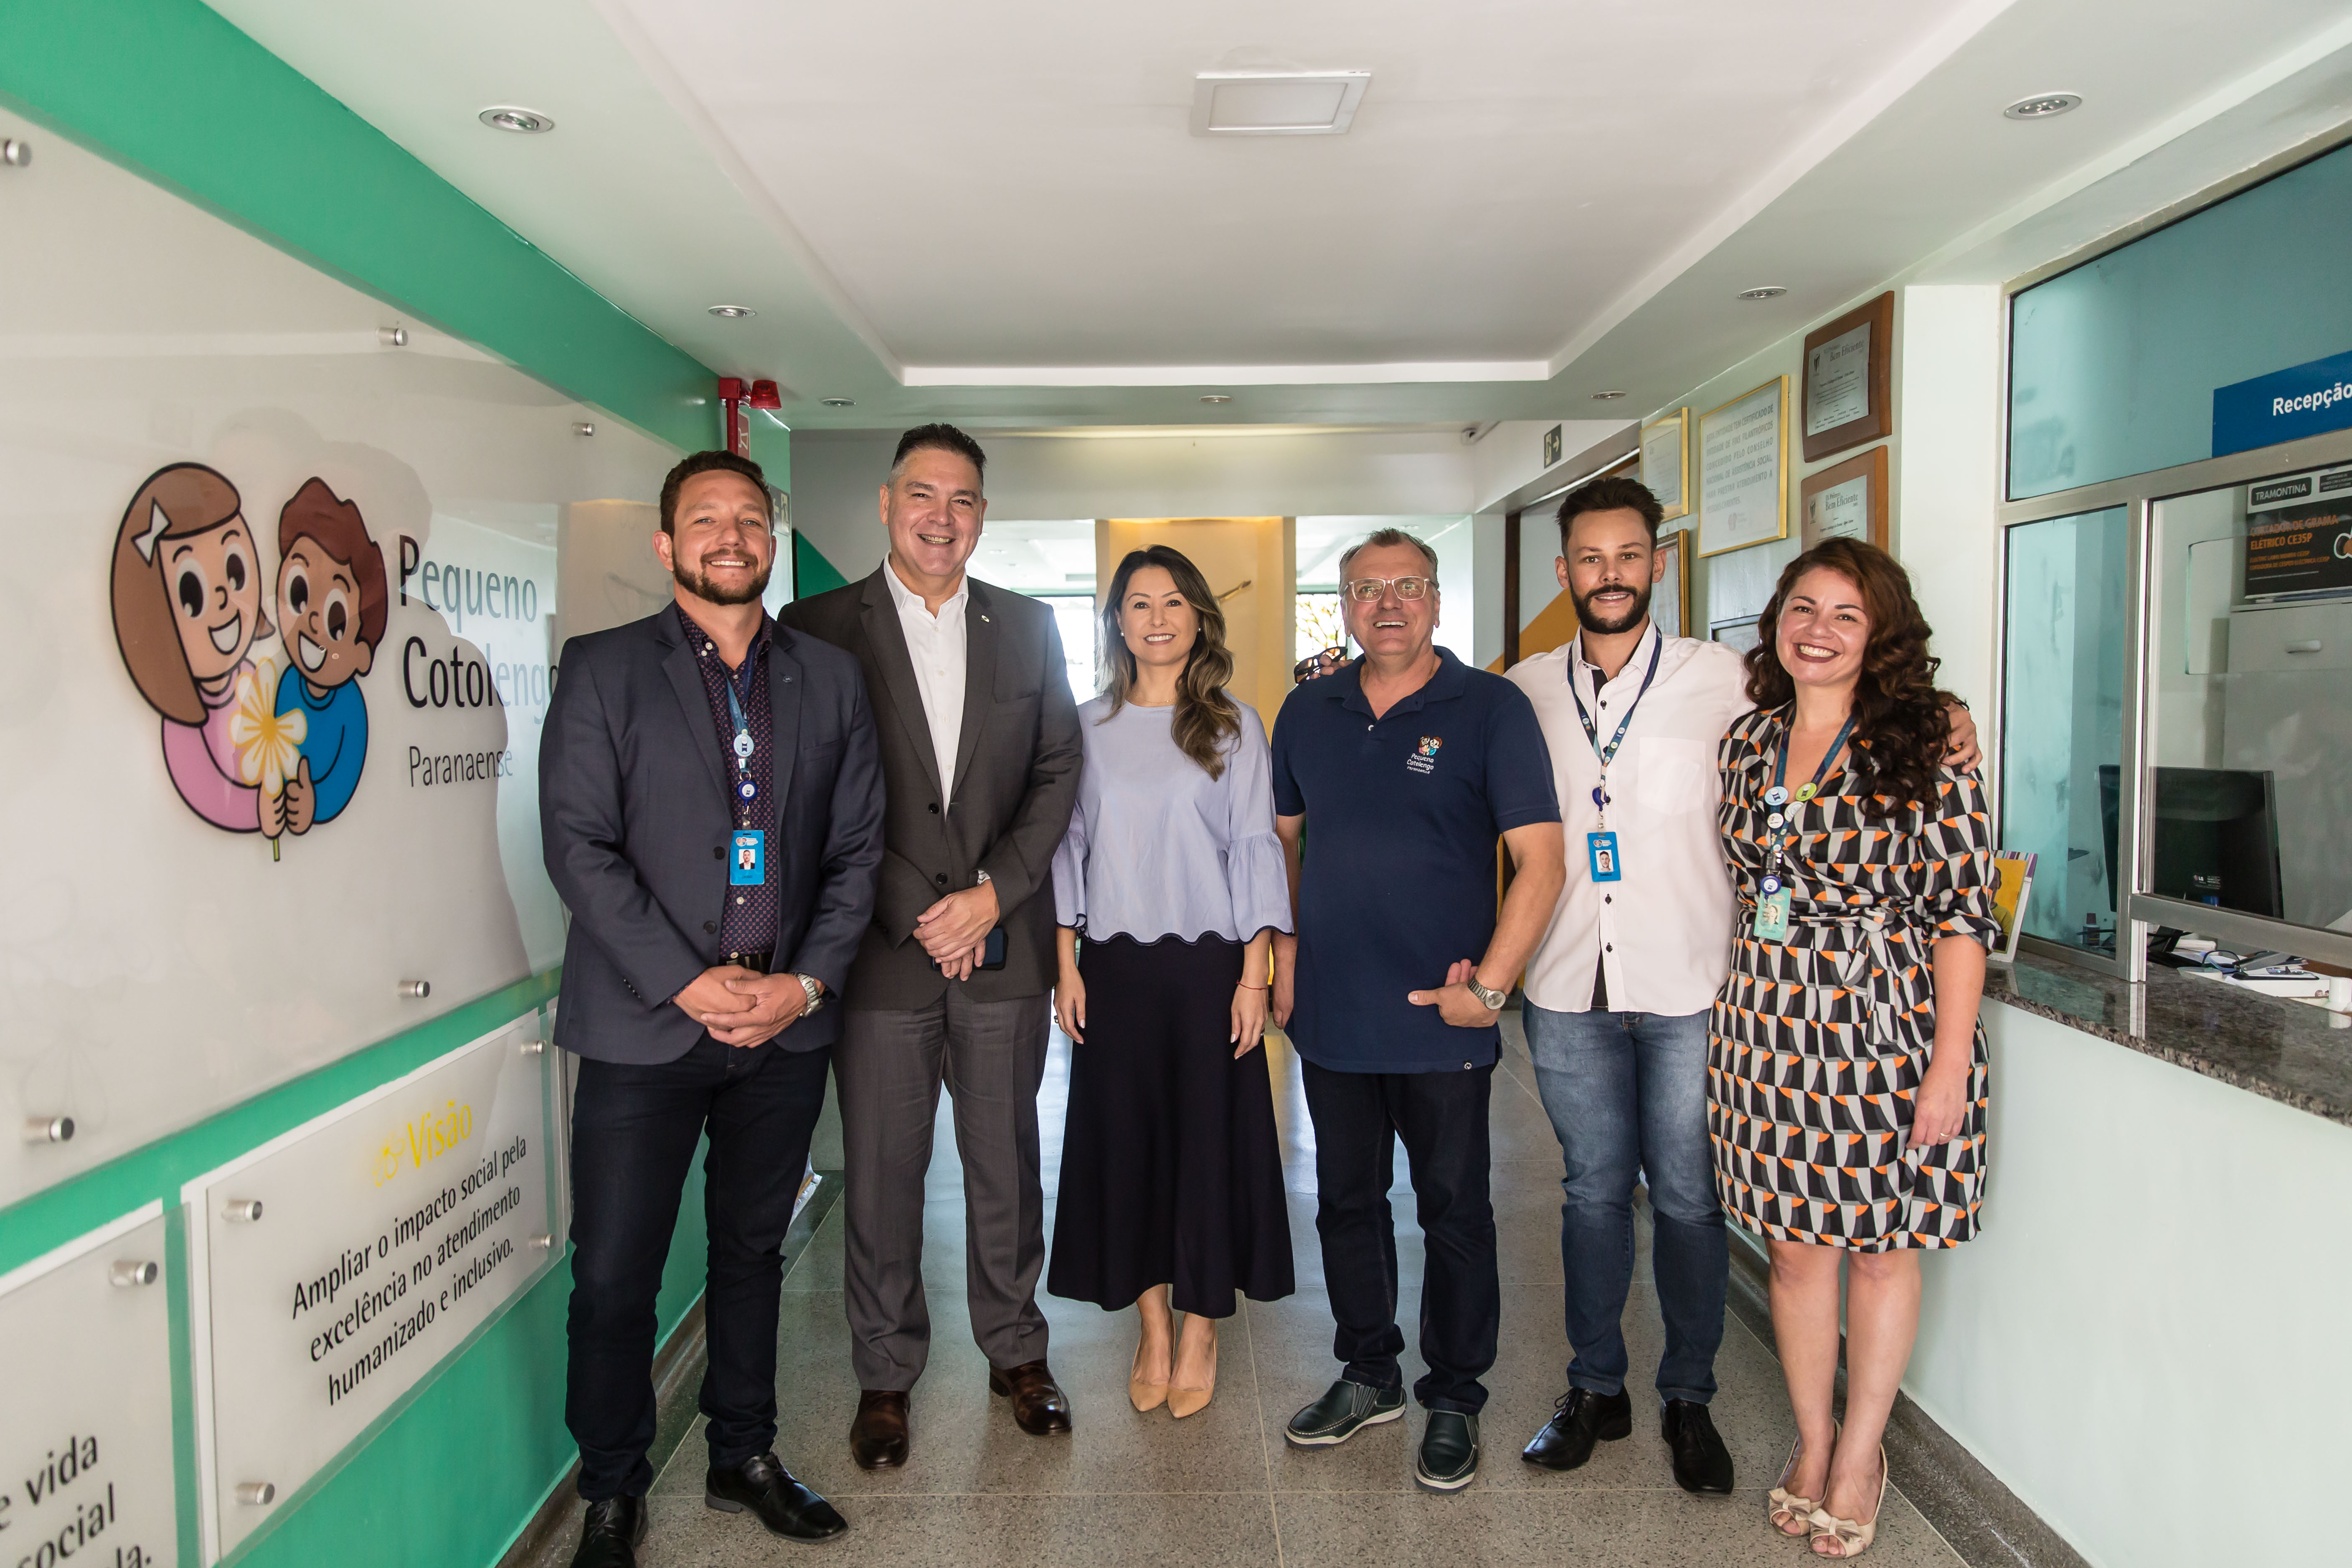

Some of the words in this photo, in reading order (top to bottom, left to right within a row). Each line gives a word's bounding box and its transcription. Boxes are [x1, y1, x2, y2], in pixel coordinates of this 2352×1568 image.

[1830, 352, 1841, 361] Bem
[1842, 340, 1864, 357] Eficiente
[2273, 382, 2352, 416] Recepção
[1742, 408, 1767, 426] CERTIFICADO
[1767, 404, 1774, 414] DE
[1725, 440, 1730, 449] DE
[1742, 421, 1773, 441] FILANTRÓPICOS
[1706, 454, 1732, 471] CONCEDIDO
[1734, 448, 1745, 459] PELO
[1747, 437, 1773, 455] CONSELHO
[1718, 483, 1735, 495] PRESTAR
[1737, 471, 1768, 490] ATENDIMENTO
[1769, 469, 1773, 478] A
[1725, 469, 1730, 479] DE
[1732, 460, 1756, 476] ASSISTÊNCIA
[1825, 501, 1836, 511] Bem
[1837, 494, 1858, 507] Eficiente
[2255, 483, 2307, 501] TRAMONTINA
[2293, 520, 2304, 530] DE
[2251, 536, 2286, 550] ELÉTRICO
[2287, 533, 2313, 545] CE35P
[399, 534, 538, 633] Pequeno
[409, 746, 513, 787] Paranaense
[1407, 759, 1434, 771] Cotolengo
[1411, 753, 1434, 763] Pequeno
[407, 1098, 472, 1169] Visão
[292, 1244, 372, 1320] Ampliar
[378, 1235, 388, 1258] o
[394, 1187, 456, 1248] impacto
[461, 1150, 498, 1201] social
[502, 1135, 526, 1179] pela
[310, 1271, 407, 1362] excelência
[413, 1254, 432, 1285] no
[437, 1186, 520, 1266] atendimento
[328, 1299, 435, 1406] humanizado
[440, 1290, 449, 1311] e
[453, 1238, 514, 1302] inclusivo.
[25, 1434, 98, 1506] vida
